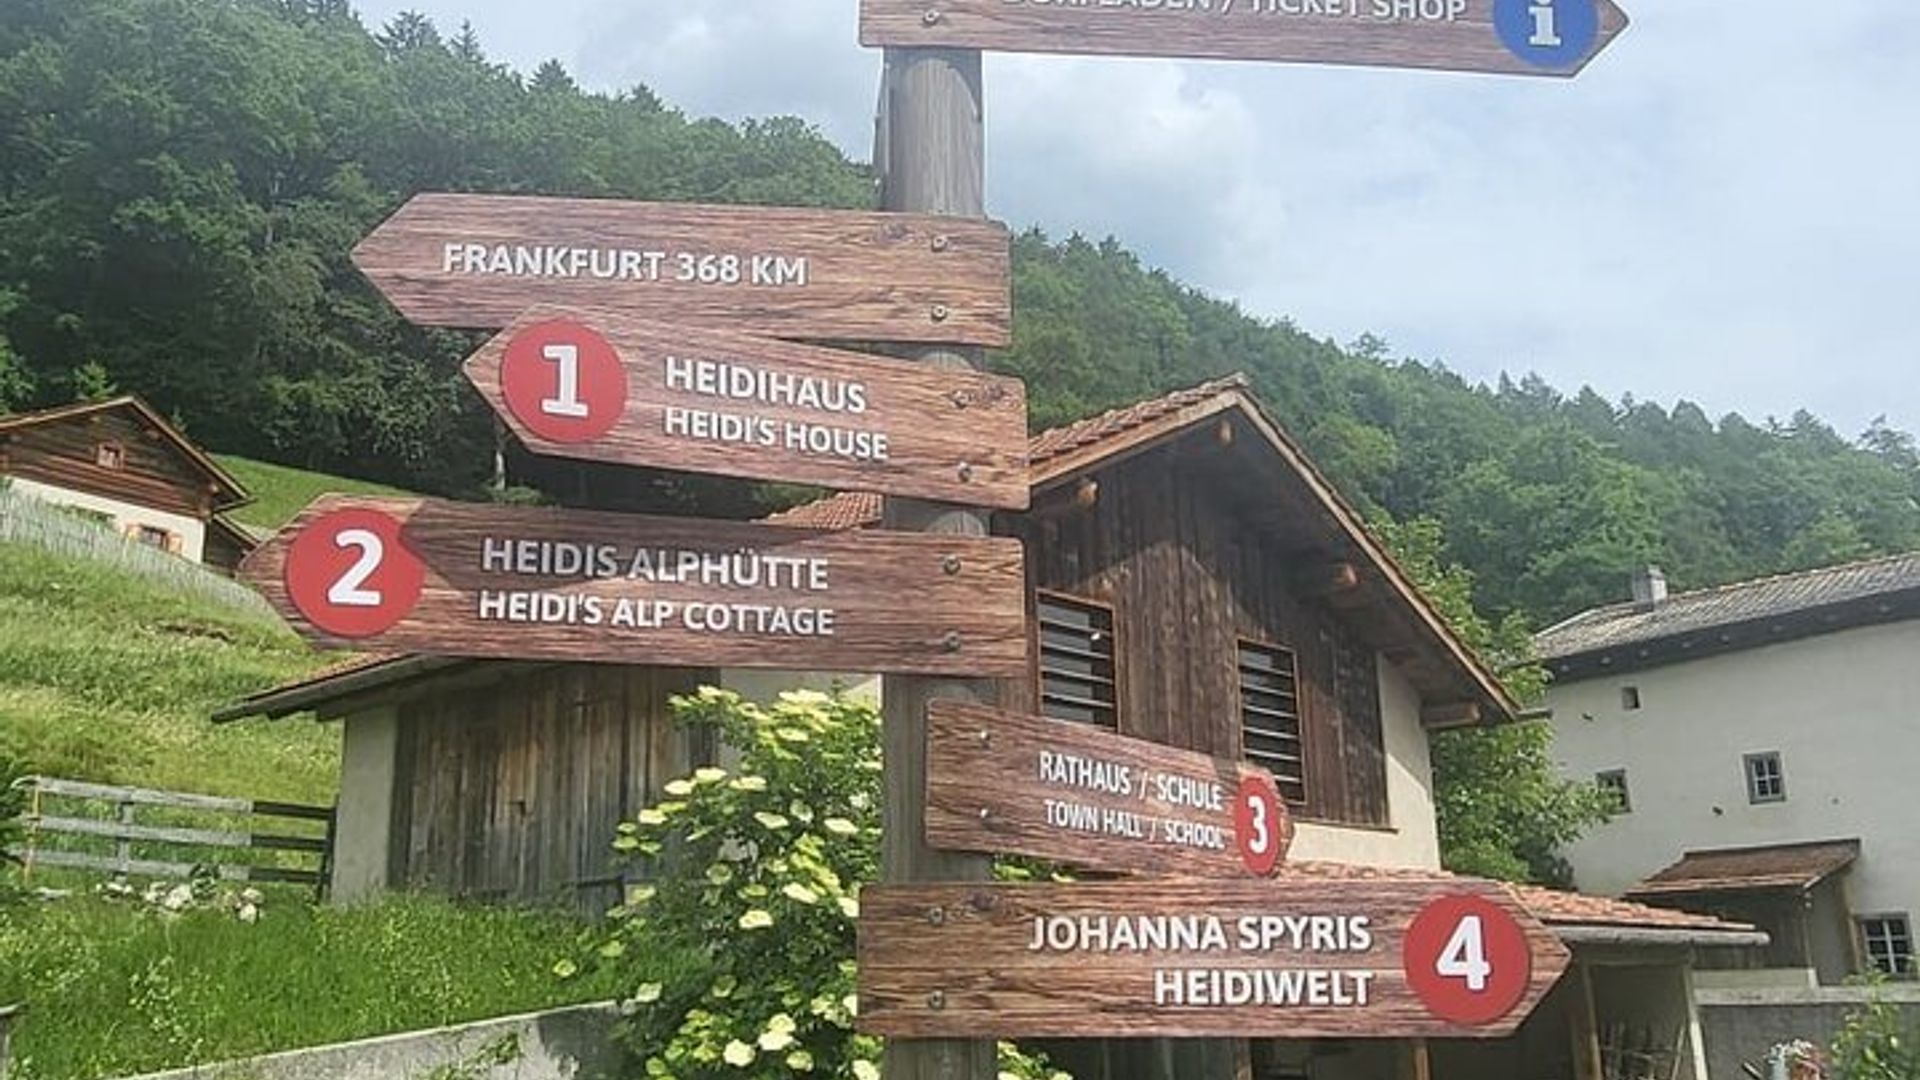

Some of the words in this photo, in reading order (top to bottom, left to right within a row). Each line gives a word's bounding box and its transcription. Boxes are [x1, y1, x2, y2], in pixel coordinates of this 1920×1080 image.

[1372, 0, 1466, 20] SHOP
[442, 243, 666, 283] FRANKFURT
[675, 251, 740, 286] 368
[750, 256, 809, 289] KM
[540, 344, 590, 418] 1
[664, 355, 868, 413] HEIDIHAUS
[663, 406, 776, 446] HEIDI'S
[783, 424, 889, 461] HOUSE
[328, 529, 384, 607] 2
[481, 536, 618, 579] HEIDIS
[629, 548, 830, 591] ALPHÜTTE
[478, 590, 603, 625] HEIDI'S
[611, 599, 674, 629] ALP
[683, 603, 835, 636] COTTAGE
[1039, 751, 1132, 795] RATHAUS
[1139, 771, 1149, 800] /
[1157, 773, 1223, 811] SCHULE
[1045, 800, 1099, 832] TOWN
[1103, 809, 1144, 839] HALL
[1165, 820, 1226, 850] SCHOOL
[1248, 795, 1269, 854] 3
[1028, 915, 1229, 953] JOHANNA
[1237, 916, 1372, 951] SPYRIS
[1435, 915, 1492, 991] 4
[1154, 970, 1372, 1007] HEIDIWELT
